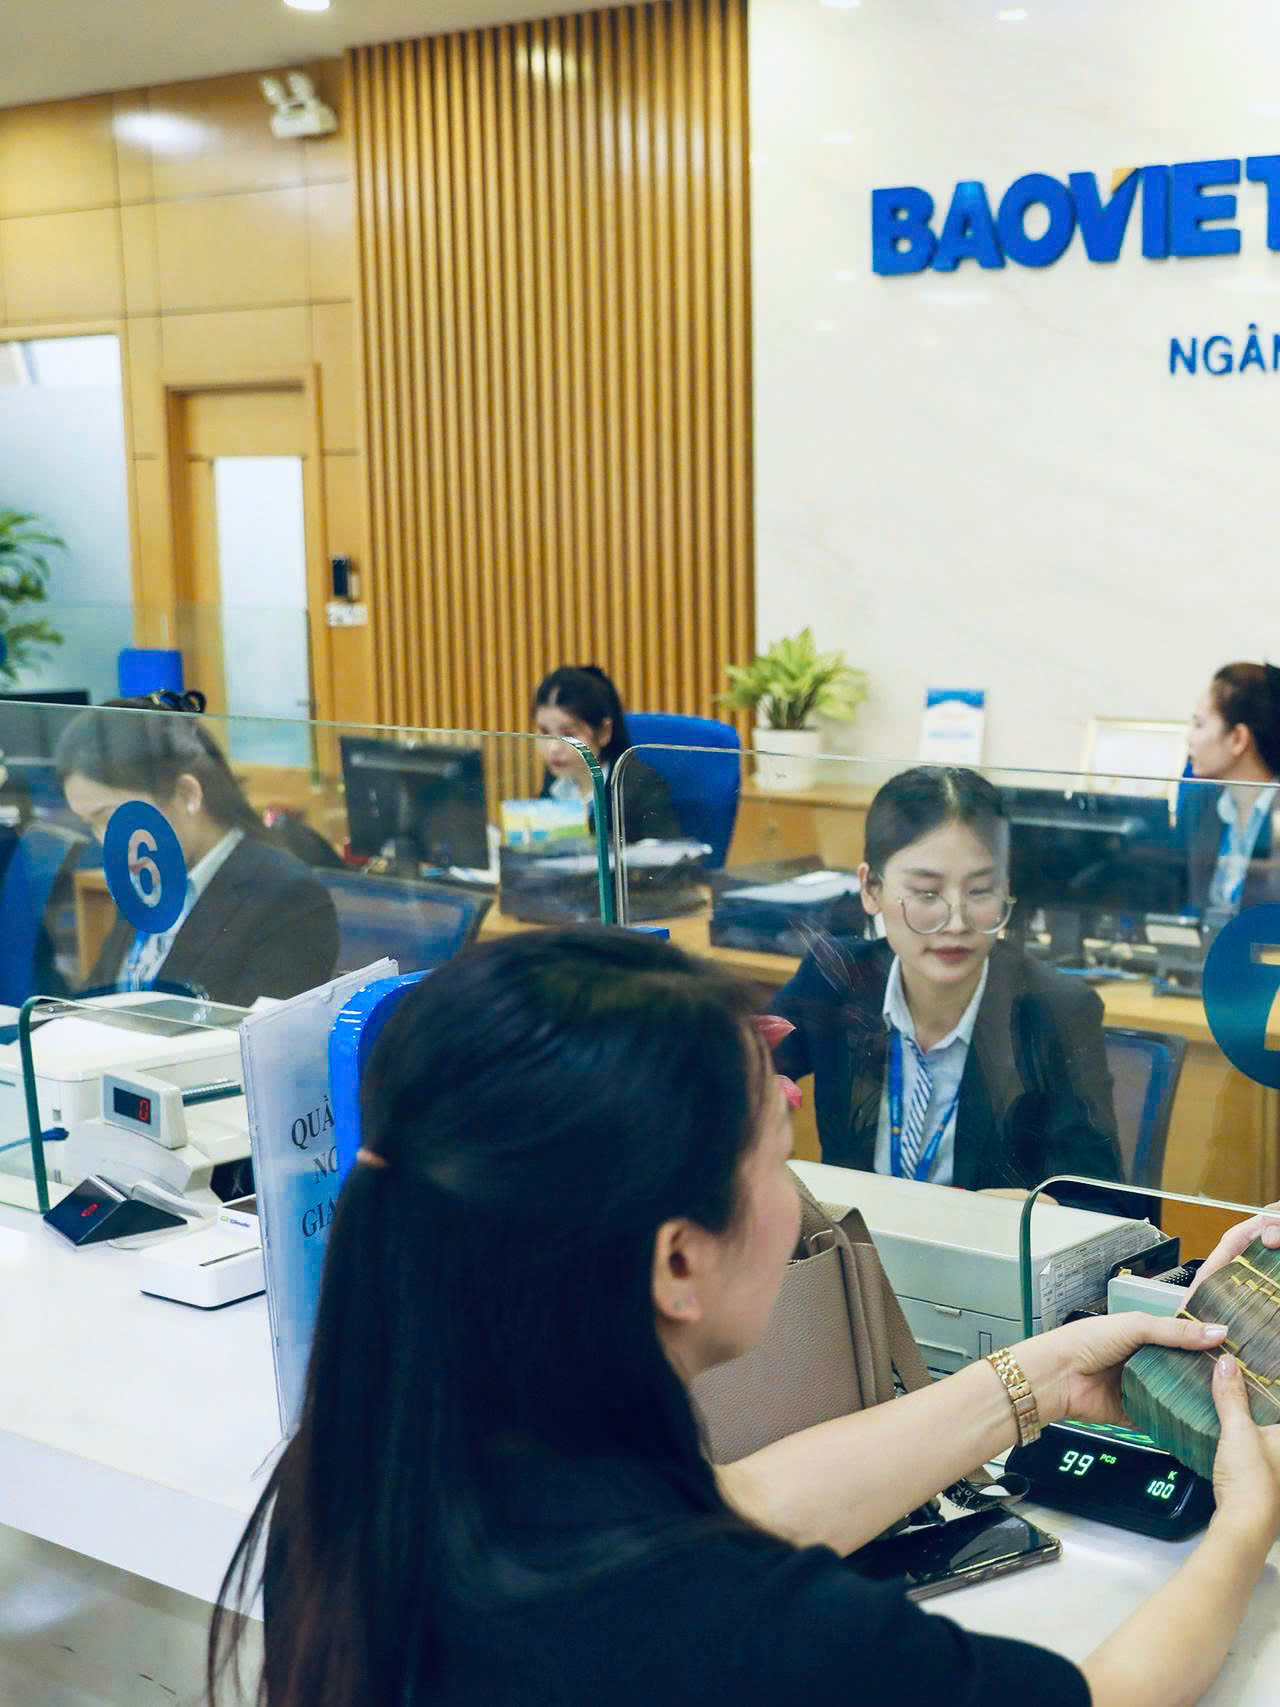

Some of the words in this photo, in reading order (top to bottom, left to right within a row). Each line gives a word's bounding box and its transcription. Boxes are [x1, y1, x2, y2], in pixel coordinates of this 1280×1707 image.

[127, 829, 162, 908] 6
[1058, 1450, 1094, 1476] 99
[1100, 1453, 1117, 1464] PCS
[1167, 1470, 1178, 1481] K
[1147, 1480, 1175, 1499] 100
